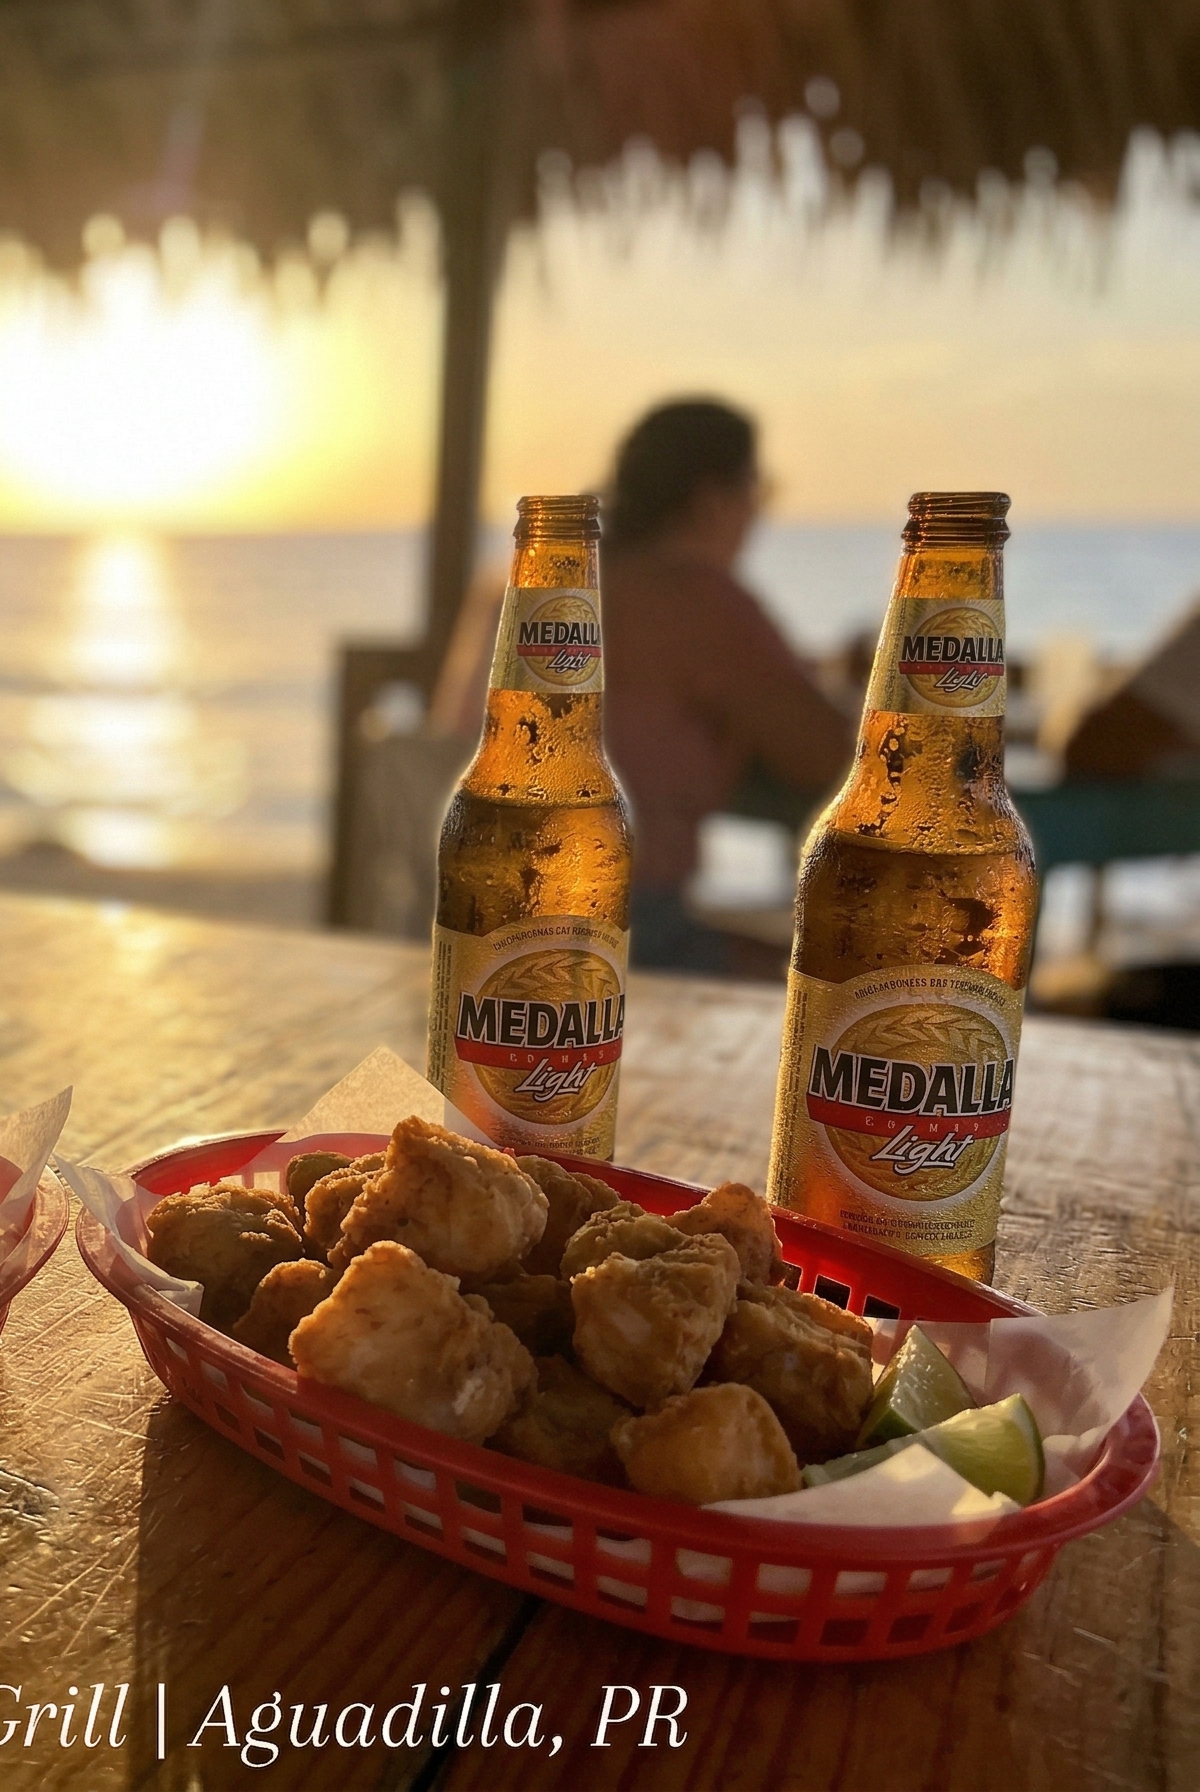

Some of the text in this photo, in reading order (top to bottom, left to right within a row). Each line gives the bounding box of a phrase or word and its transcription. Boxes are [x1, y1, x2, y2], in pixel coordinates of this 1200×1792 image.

[901, 635, 1004, 664] MEDALLA
[456, 991, 625, 1049] MEDALLA
[513, 1058, 598, 1103] Light
[808, 1043, 1016, 1117] MEDALLA
[869, 1124, 975, 1175] Light
